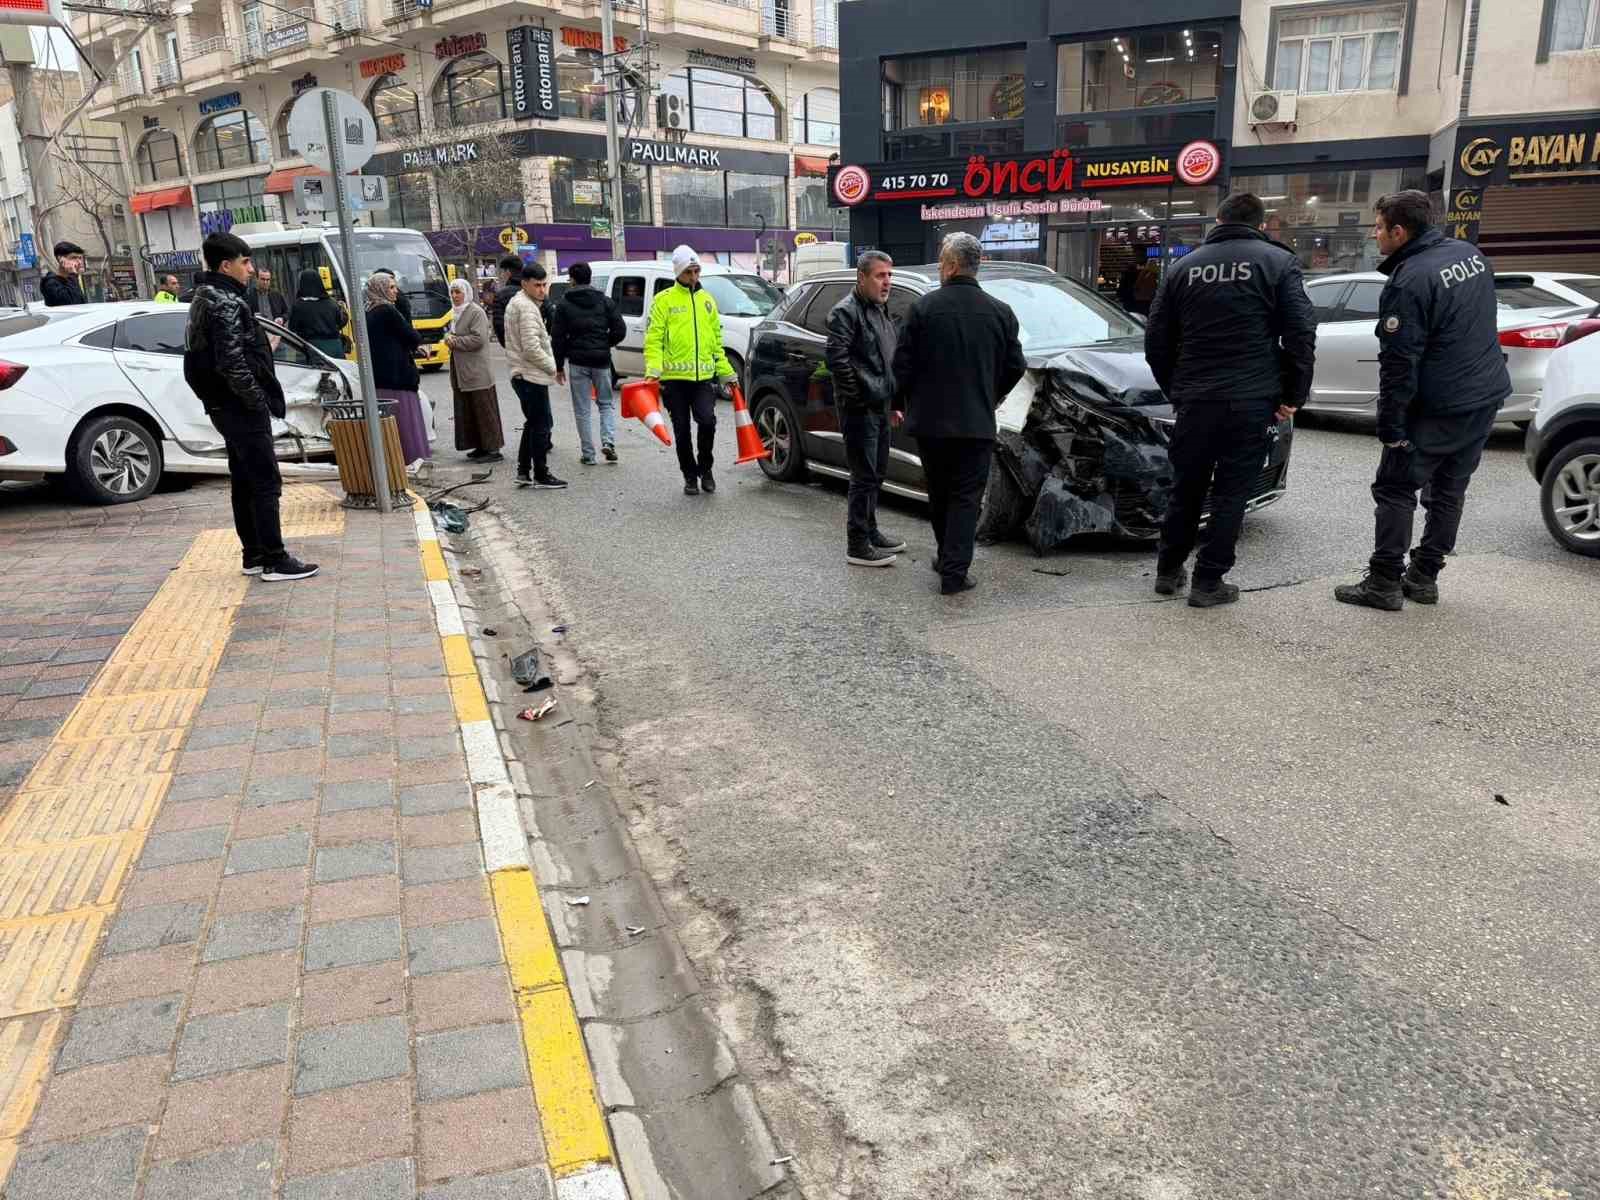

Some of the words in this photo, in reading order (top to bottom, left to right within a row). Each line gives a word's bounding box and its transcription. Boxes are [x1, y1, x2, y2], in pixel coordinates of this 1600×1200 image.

[512, 43, 526, 111] ottoman
[538, 42, 553, 110] ottoman
[632, 142, 720, 166] PAULMARK
[1507, 133, 1586, 166] BAYAN
[1087, 155, 1169, 177] NUSAYBİN
[882, 176, 905, 190] 415
[909, 175, 927, 188] 70
[931, 173, 948, 186] 70
[1447, 210, 1481, 222] BAYAN
